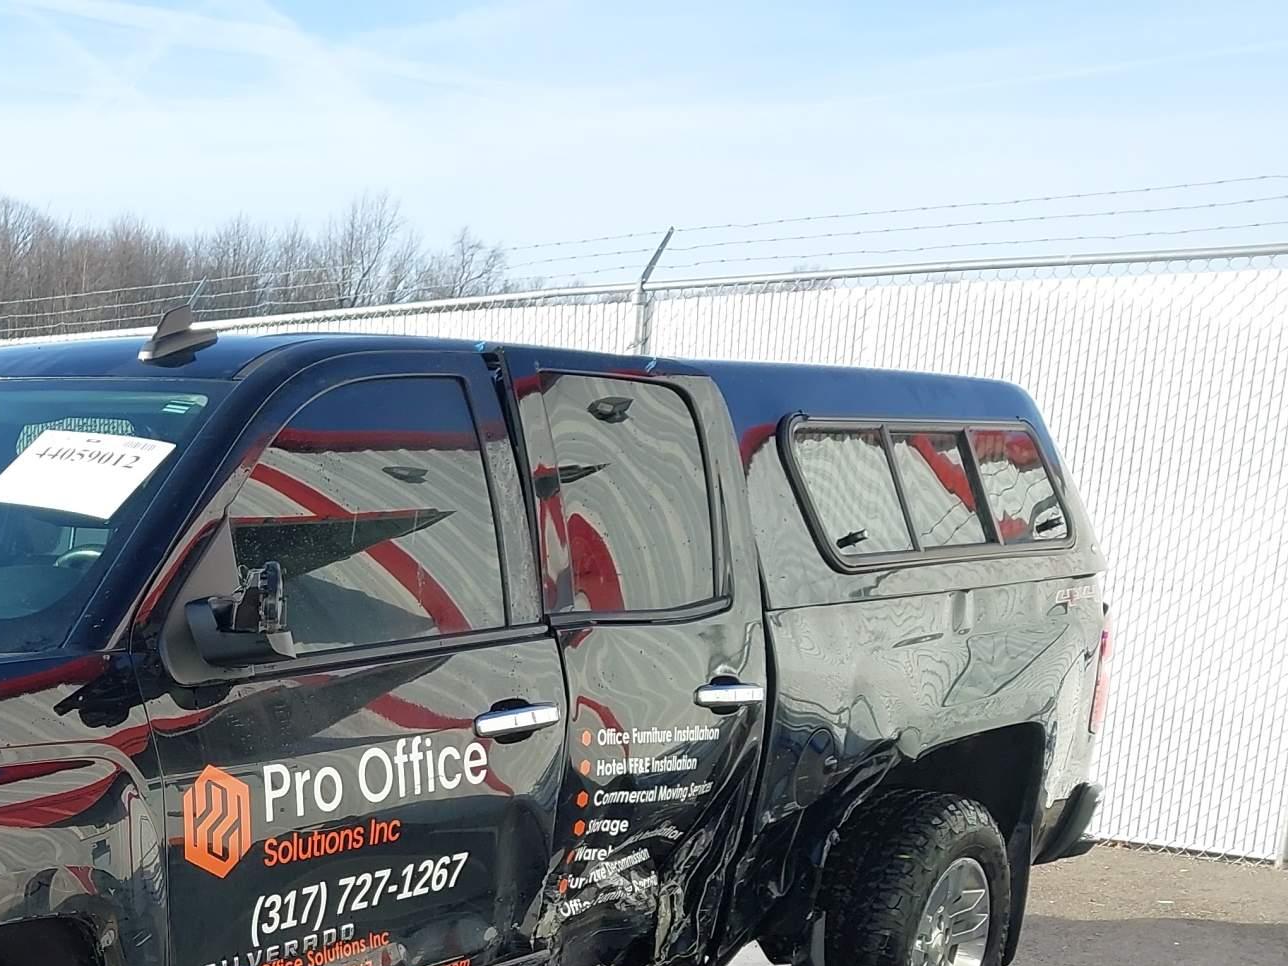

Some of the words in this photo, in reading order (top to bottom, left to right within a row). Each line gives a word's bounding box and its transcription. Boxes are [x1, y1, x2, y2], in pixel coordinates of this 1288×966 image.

[36, 446, 141, 469] 44059012
[597, 728, 630, 746] Office
[632, 727, 672, 744] Furniture
[674, 726, 720, 741] Installation
[596, 758, 626, 776] Hotel
[628, 757, 649, 774] FF&E
[651, 755, 697, 773] Installation
[263, 763, 343, 822] Pro
[358, 736, 488, 802] Office
[593, 786, 657, 807] Commercial
[658, 784, 688, 802] Moving
[586, 818, 629, 836] Storage
[264, 826, 364, 867] Solutions
[370, 819, 401, 844] Inc
[251, 881, 328, 948] (317)
[336, 852, 469, 914] 727-1267
[368, 930, 391, 951] Inc
